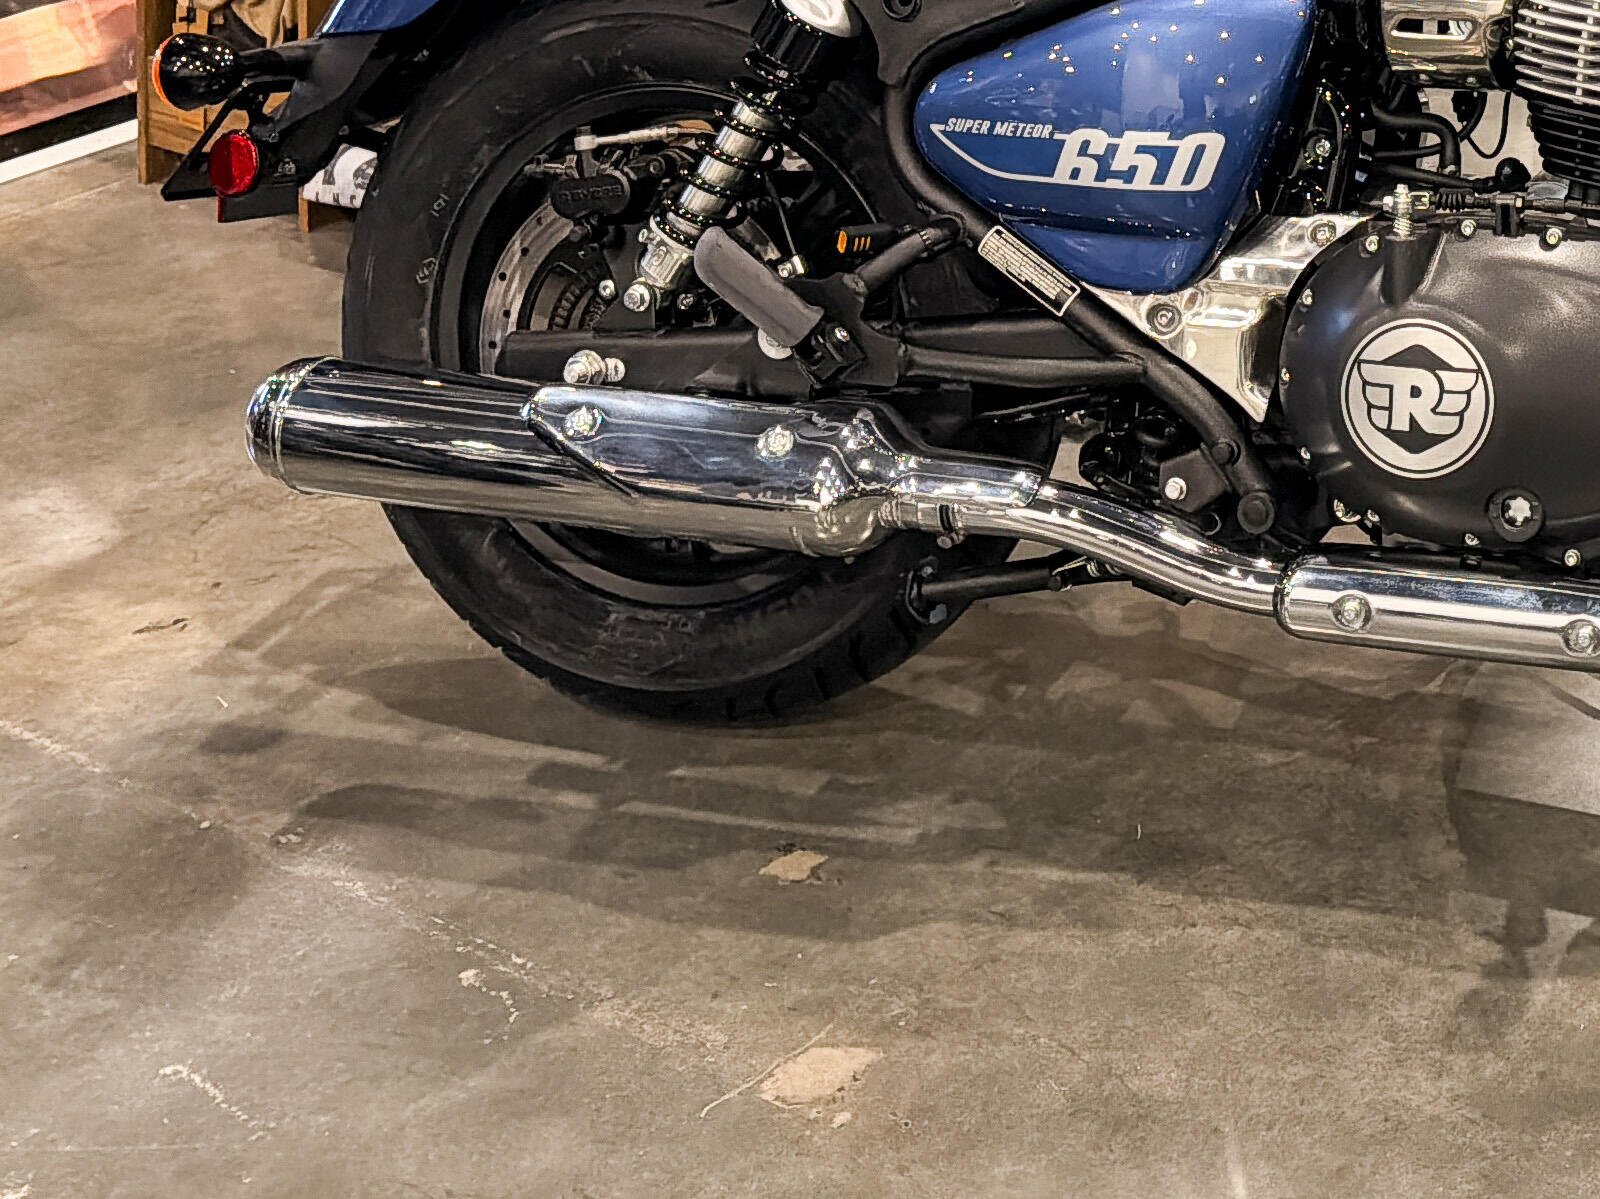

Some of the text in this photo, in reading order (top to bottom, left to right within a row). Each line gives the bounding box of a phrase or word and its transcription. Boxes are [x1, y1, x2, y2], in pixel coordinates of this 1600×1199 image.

[945, 117, 1226, 192] SUPER METEOR 650
